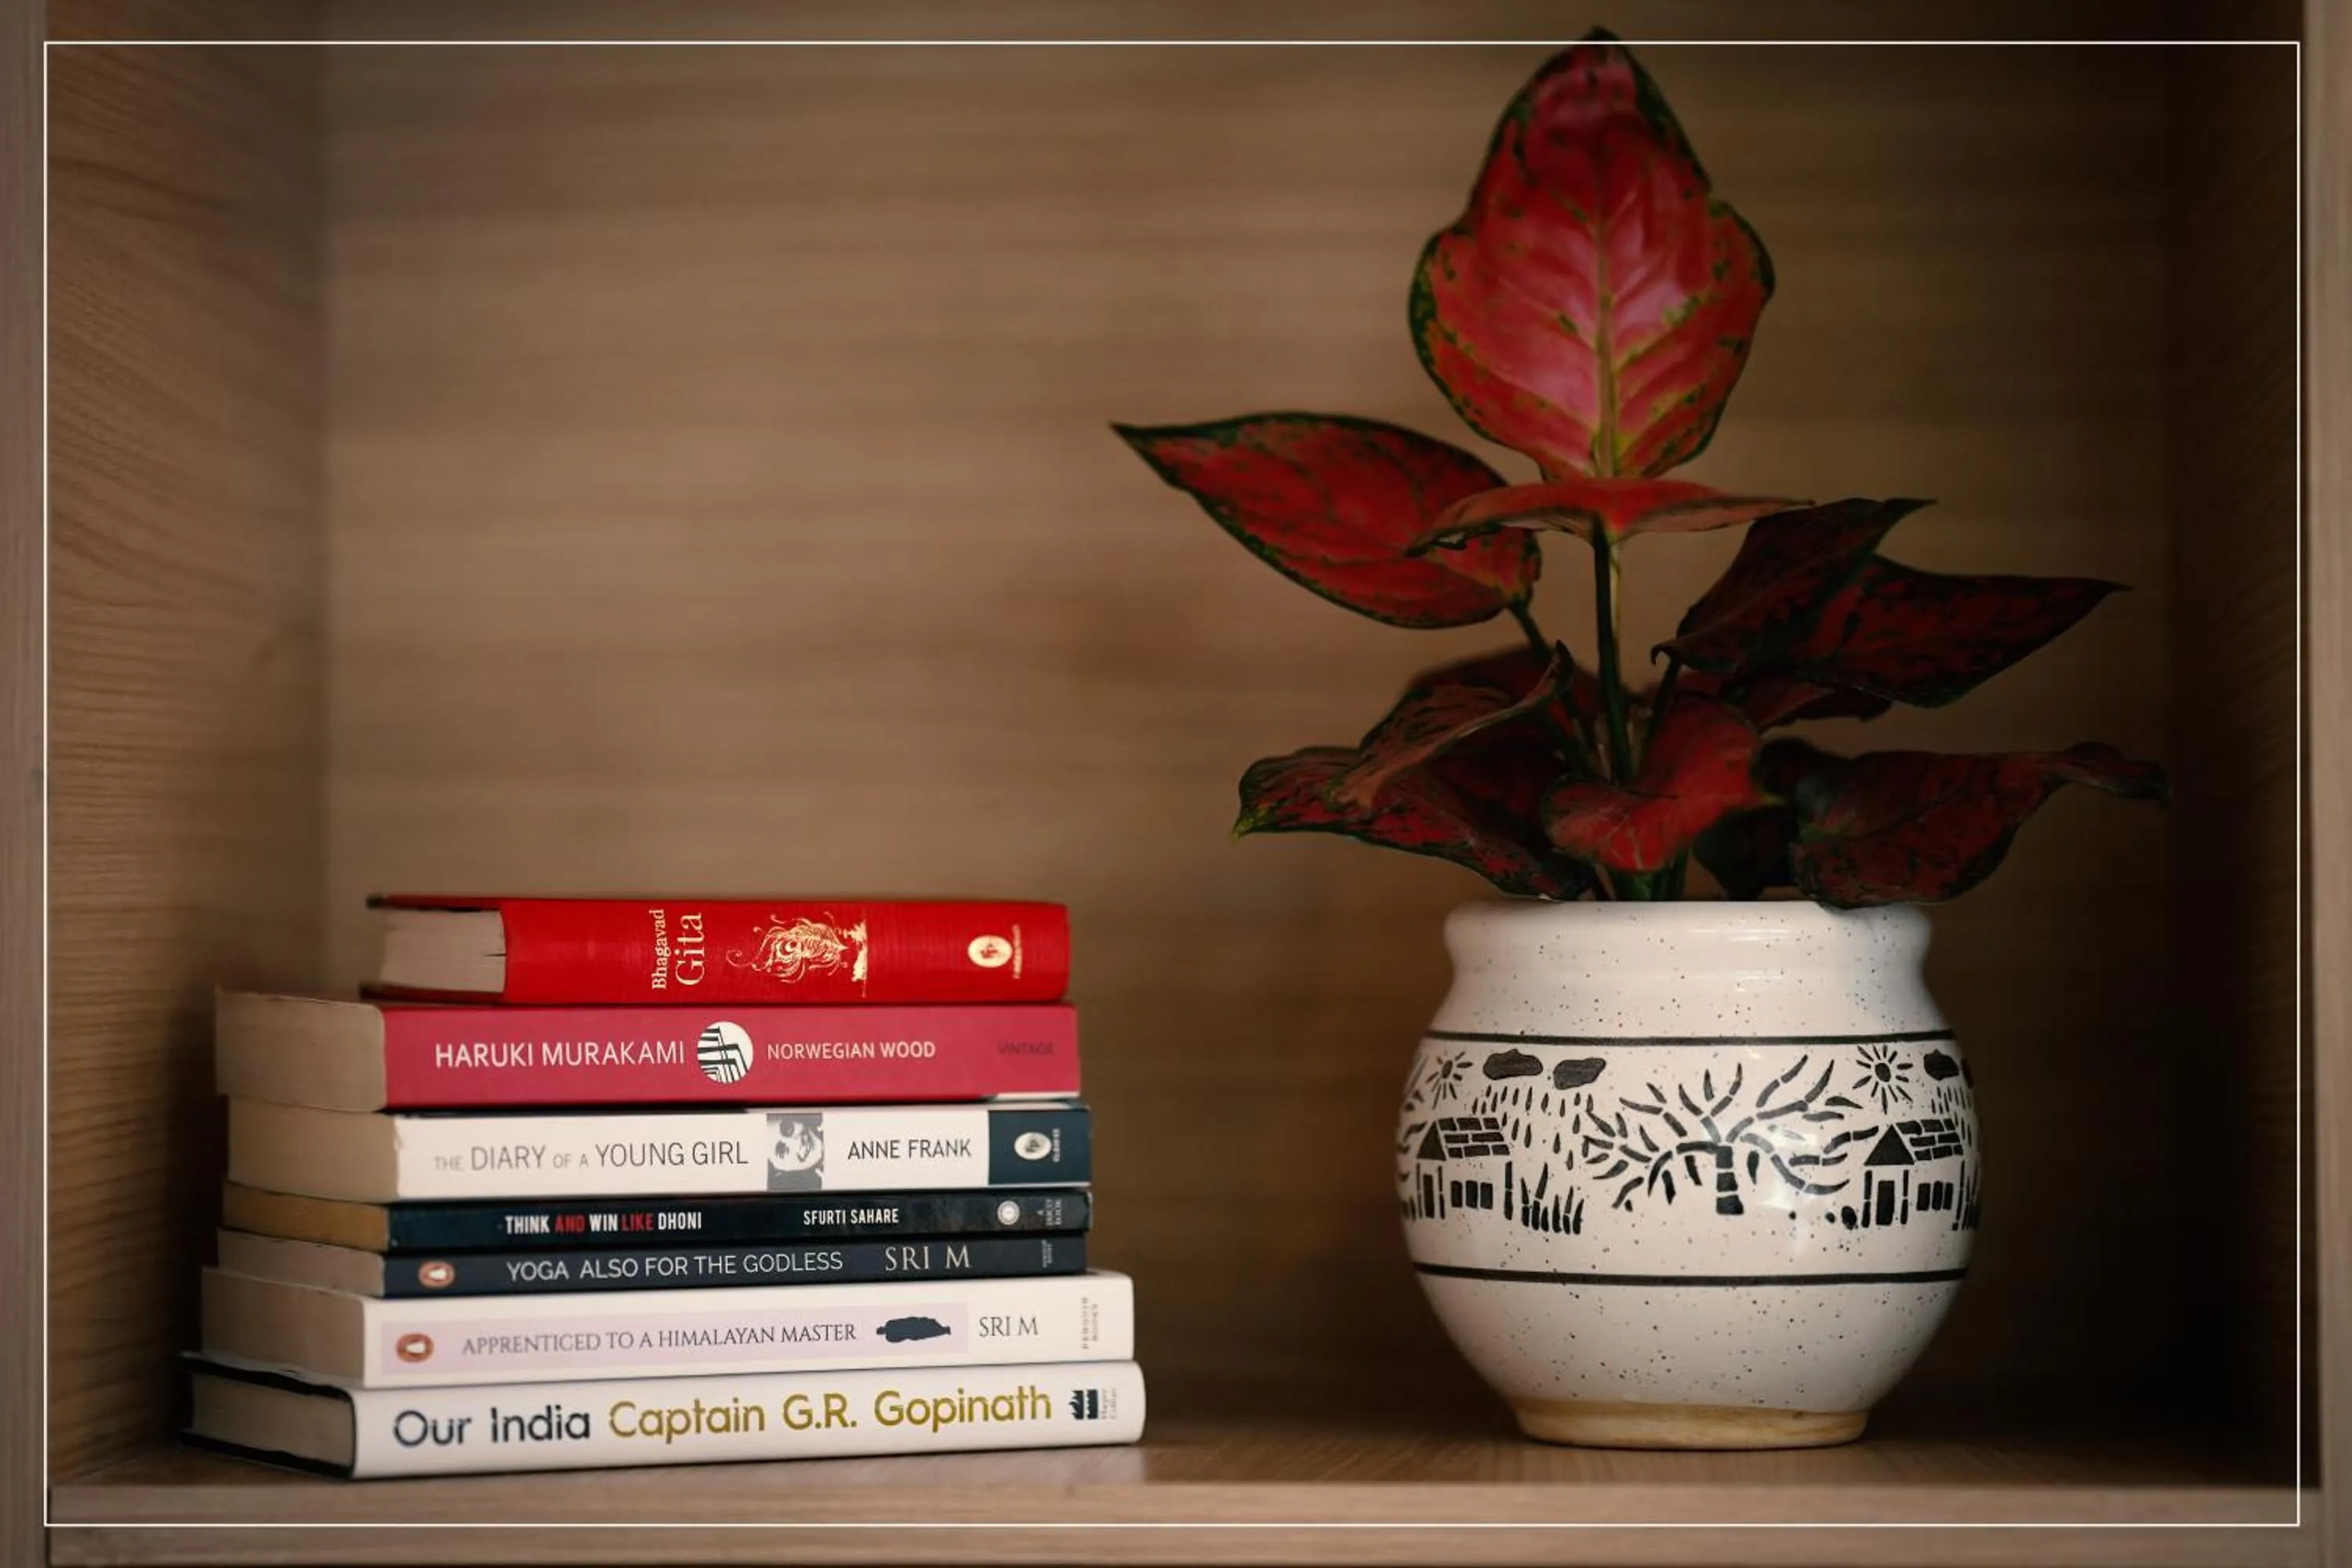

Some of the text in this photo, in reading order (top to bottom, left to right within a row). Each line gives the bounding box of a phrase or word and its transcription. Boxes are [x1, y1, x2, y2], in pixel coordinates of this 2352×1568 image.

[648, 908, 670, 989] Bhagavad
[675, 913, 705, 986] Gita
[435, 1040, 685, 1069] HARUKI MURAKAMI
[767, 1040, 936, 1061] NORWEGIAN WOOD
[997, 1042, 1054, 1056] VINTAGE
[434, 1141, 749, 1171] THE DIARY OF A YOUNG GIRL
[848, 1138, 972, 1160] ANNE FRANK
[505, 1212, 702, 1235] THINK AND WIN LIKE DHONI
[804, 1208, 899, 1226] SFURTI SAHARE
[506, 1251, 843, 1282] YOGA ALSO FOR THE GODLESS
[885, 1245, 972, 1272] SRI M
[462, 1323, 857, 1356] APPRENTICED TO A HIMALAYAN MASTER
[978, 1316, 1040, 1338] SRI M
[393, 1385, 1052, 1447] Our India Captain G.R. Gopinath
